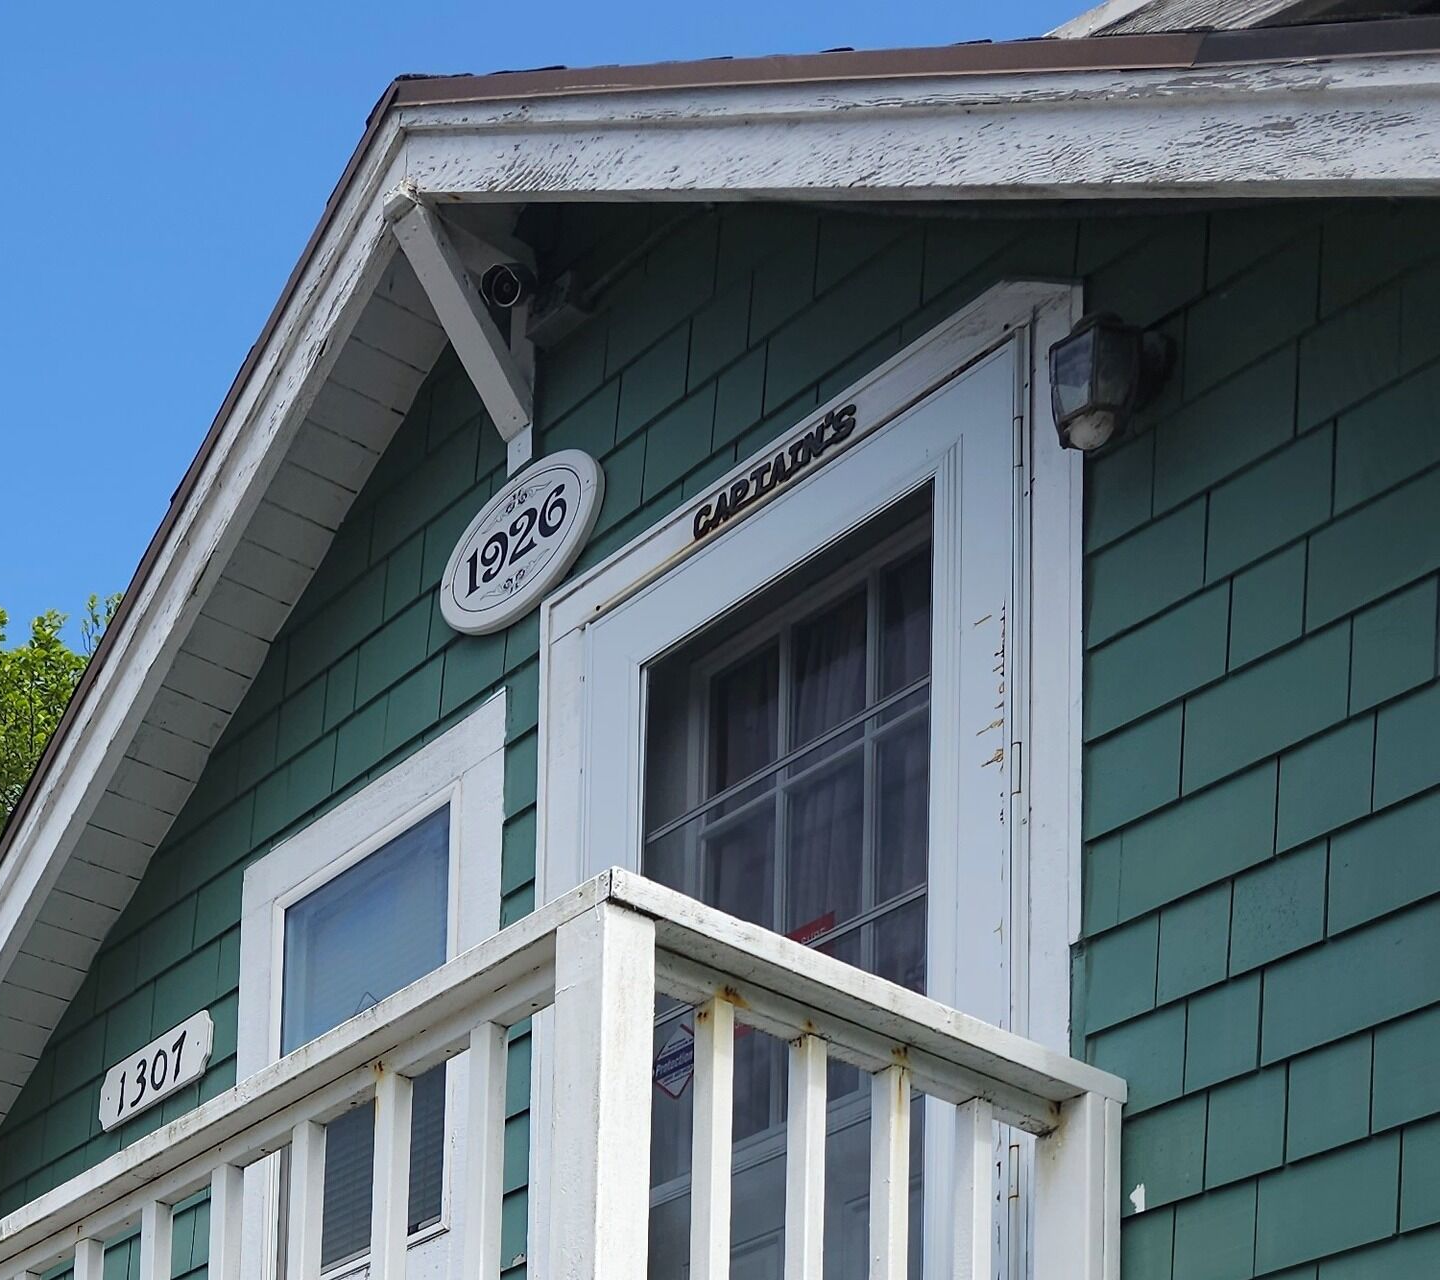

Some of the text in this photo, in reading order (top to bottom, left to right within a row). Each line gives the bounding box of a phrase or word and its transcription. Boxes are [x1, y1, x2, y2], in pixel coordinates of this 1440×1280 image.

[692, 403, 858, 541] CAPTAIN'S
[464, 483, 568, 599] 1926
[116, 1029, 188, 1118] 1307
